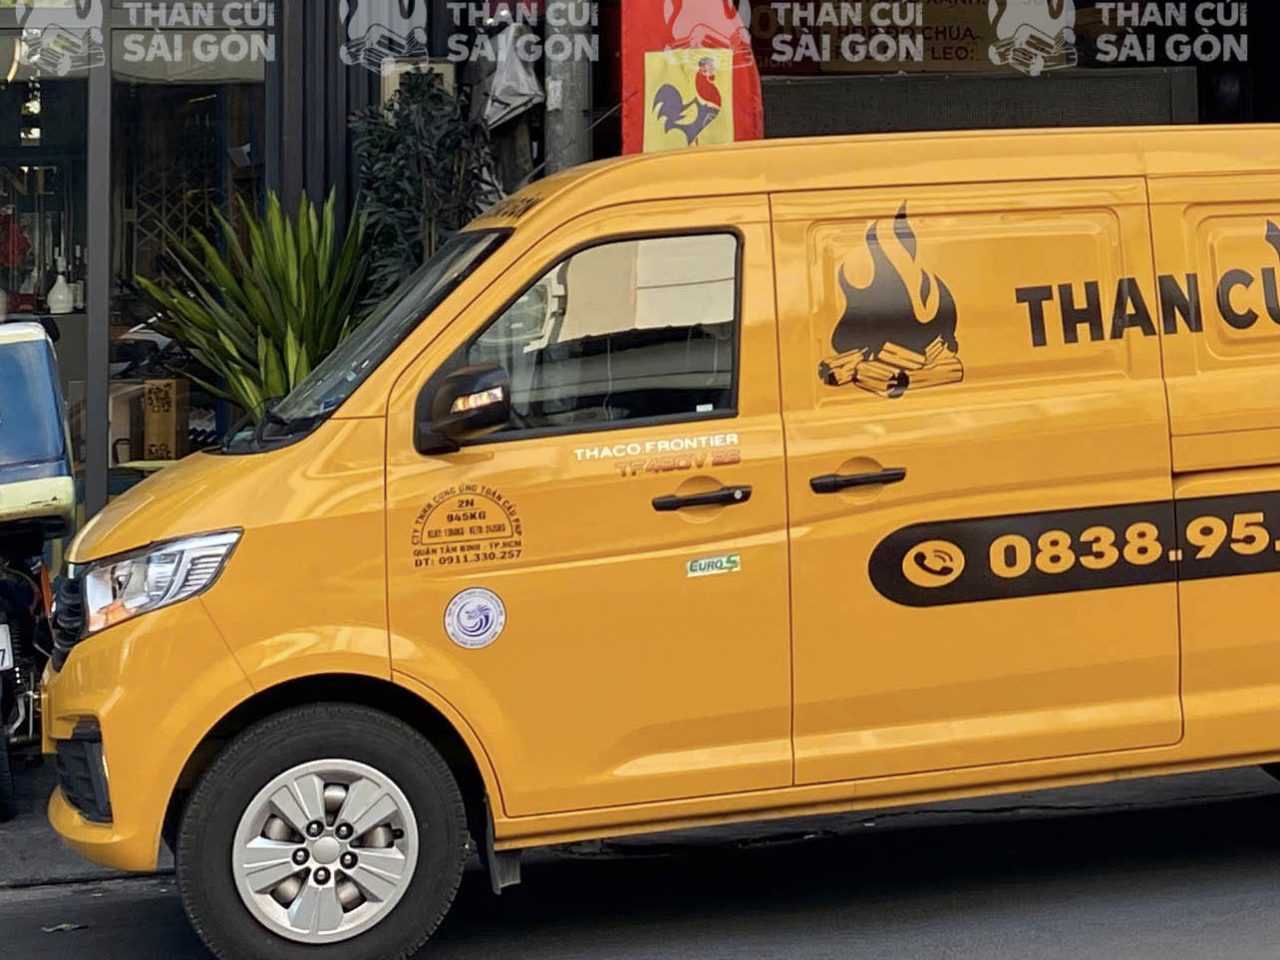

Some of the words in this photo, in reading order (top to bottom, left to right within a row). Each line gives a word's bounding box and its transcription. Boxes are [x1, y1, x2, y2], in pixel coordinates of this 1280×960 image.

[1015, 271, 1204, 348] THAN
[573, 442, 641, 461] THACO
[645, 433, 739, 454] FRONTIER
